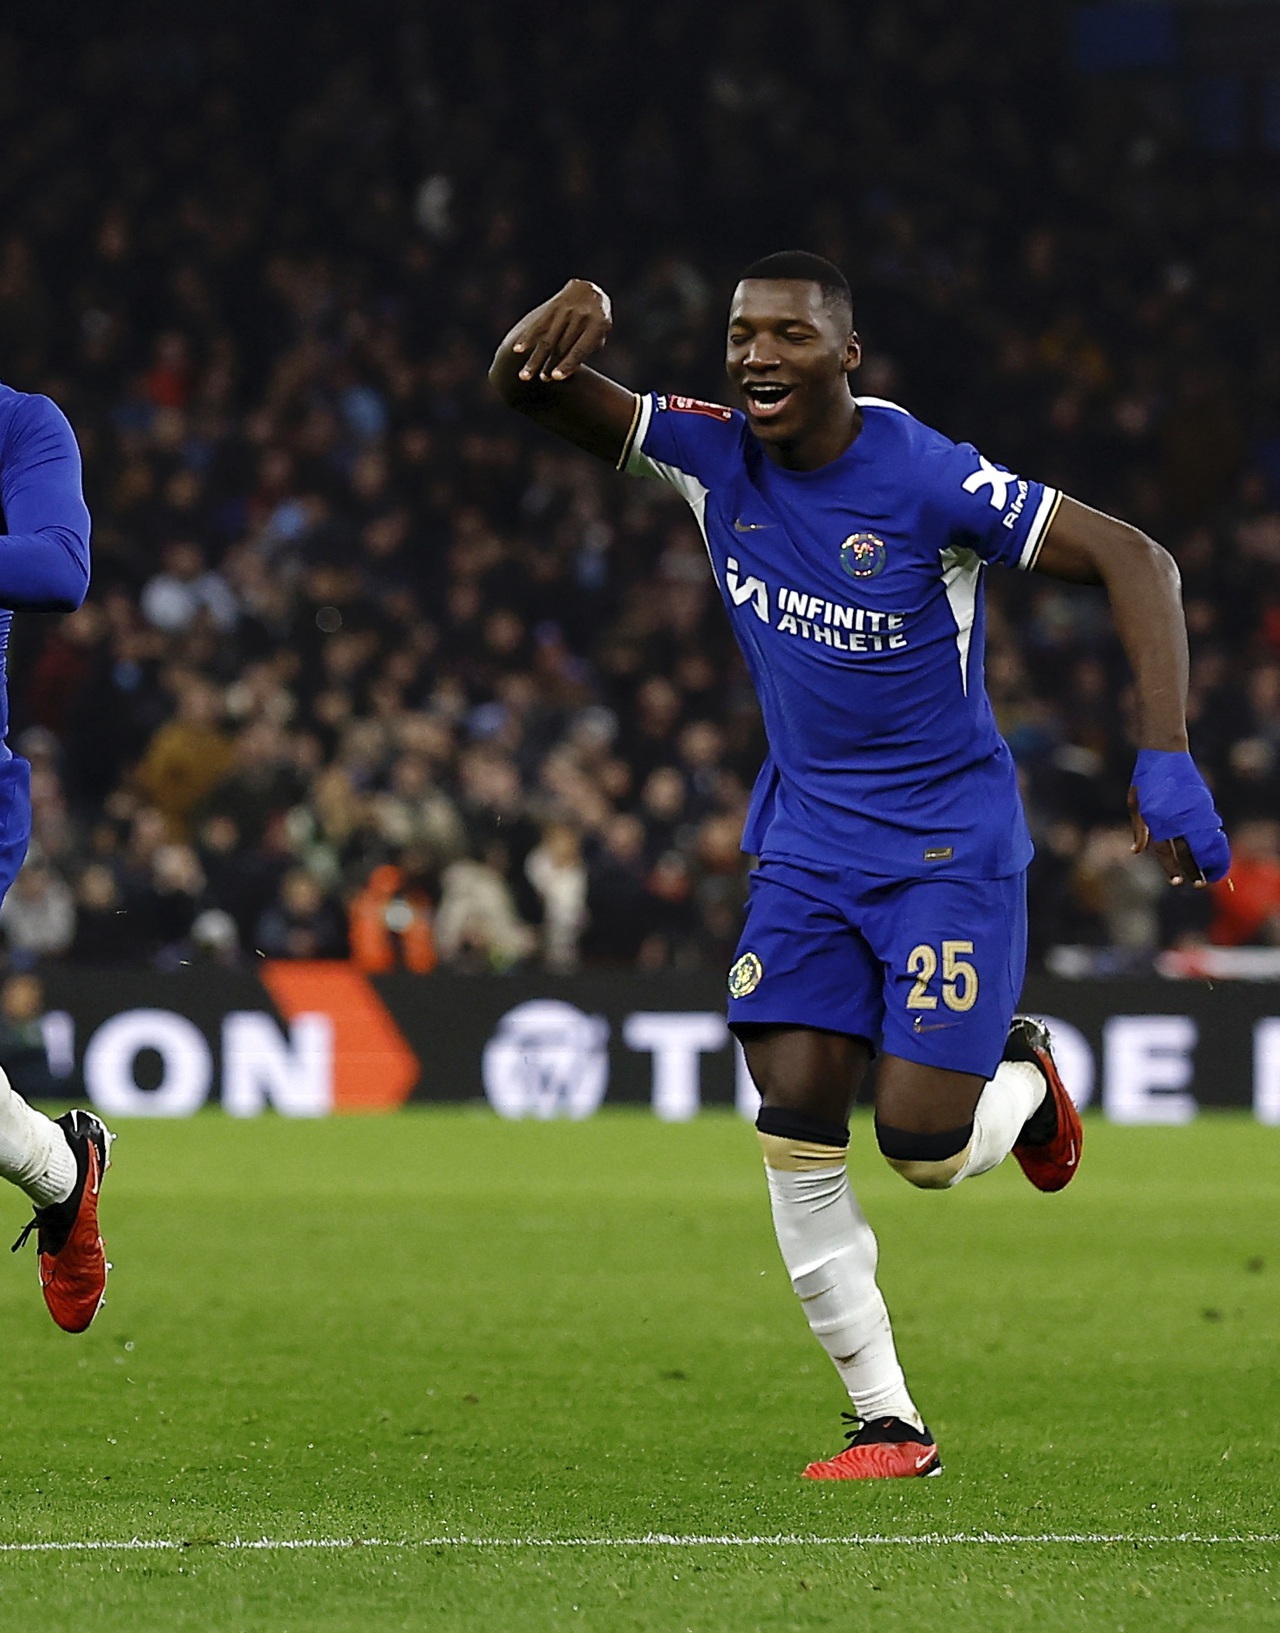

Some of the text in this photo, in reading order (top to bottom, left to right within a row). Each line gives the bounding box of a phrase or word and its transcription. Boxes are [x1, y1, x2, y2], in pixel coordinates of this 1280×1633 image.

[777, 587, 906, 632] INFINITE
[777, 613, 908, 652] ATHLETE
[906, 940, 979, 1012] 25
